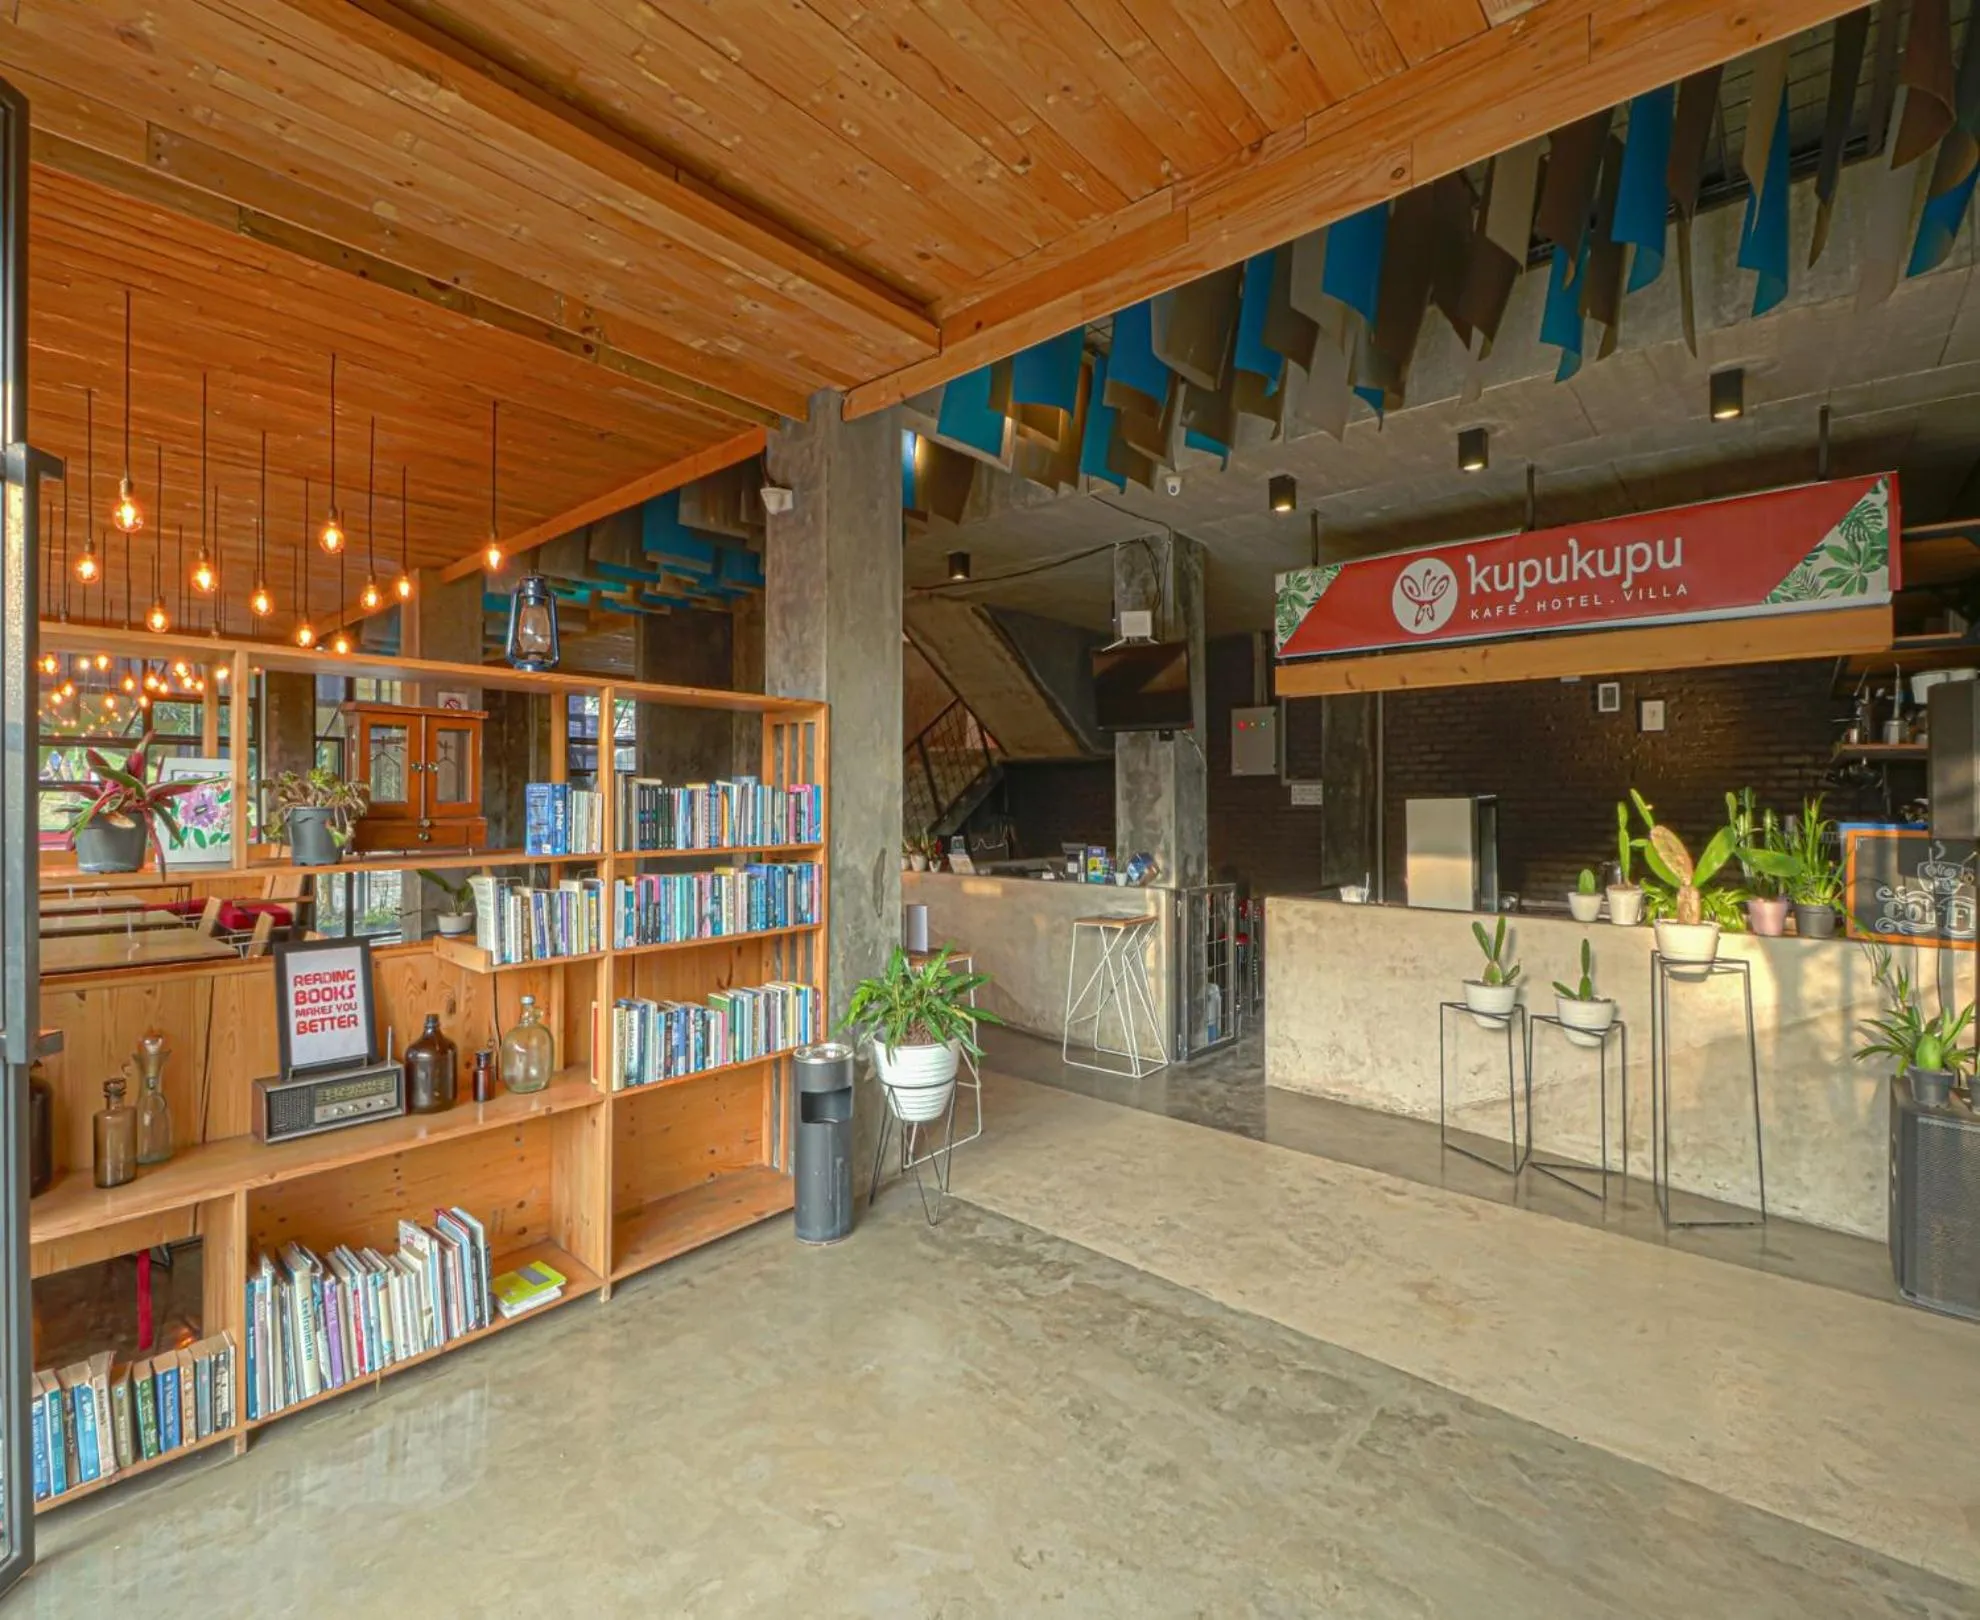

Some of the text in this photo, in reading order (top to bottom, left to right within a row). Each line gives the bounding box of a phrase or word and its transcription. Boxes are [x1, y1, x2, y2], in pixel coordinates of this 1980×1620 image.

[1466, 537, 1683, 603] kupukupu
[1471, 583, 1688, 620] KAFE HOTEL VILLA
[293, 969, 356, 987] READING
[294, 984, 357, 1006] BOOKS
[295, 1002, 358, 1018] MAKES YOU
[296, 1014, 359, 1035] BETTER
